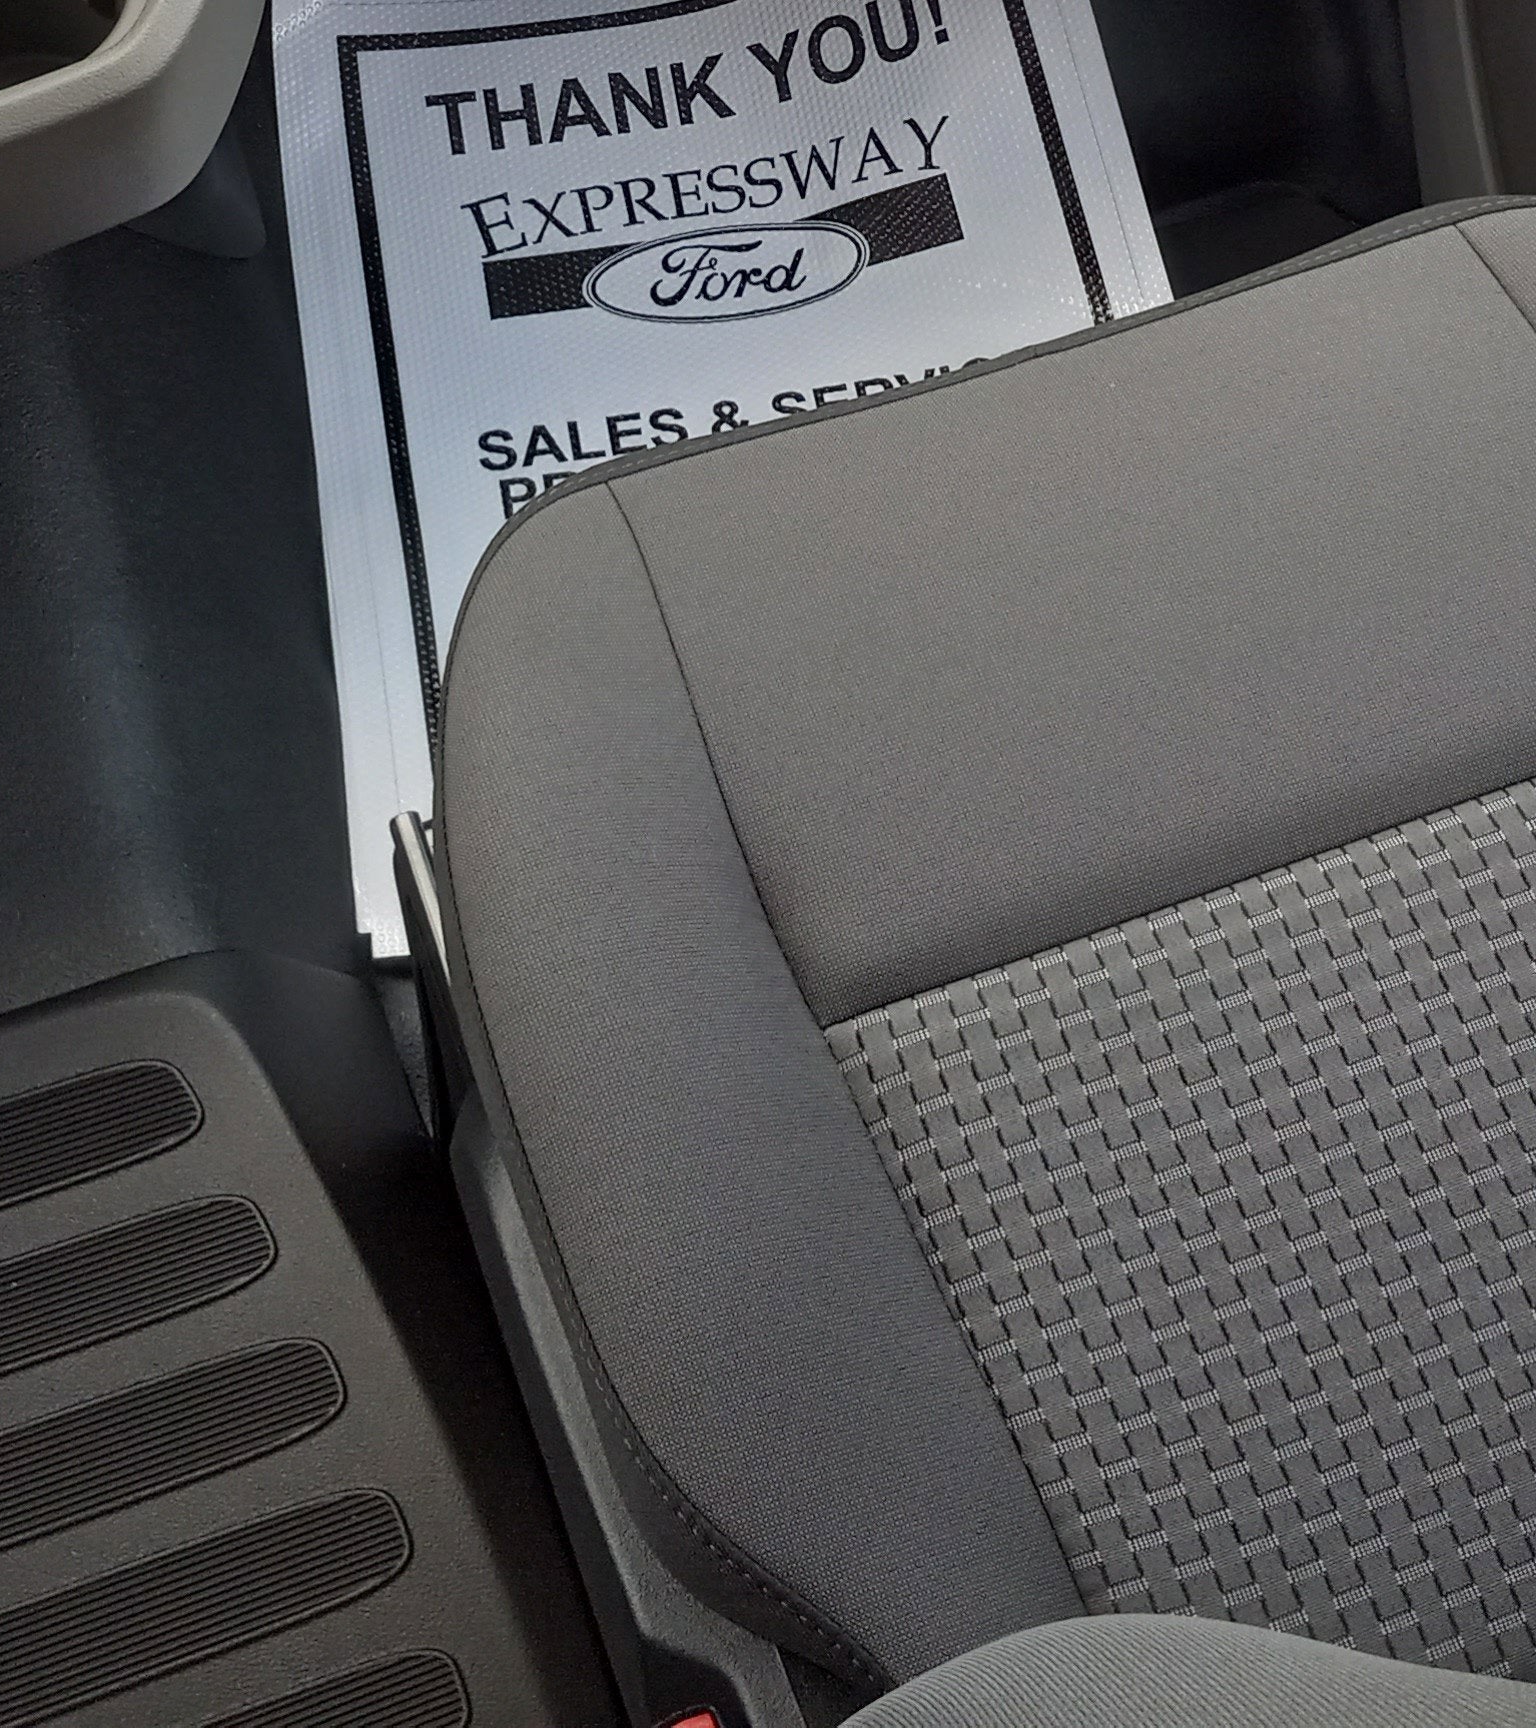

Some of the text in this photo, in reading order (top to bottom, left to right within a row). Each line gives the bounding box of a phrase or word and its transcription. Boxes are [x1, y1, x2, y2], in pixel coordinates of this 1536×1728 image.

[424, 52, 737, 156] THANK
[460, 114, 951, 259] EXPRESSWAY
[648, 239, 809, 307] Ford
[477, 407, 690, 472] SALES
